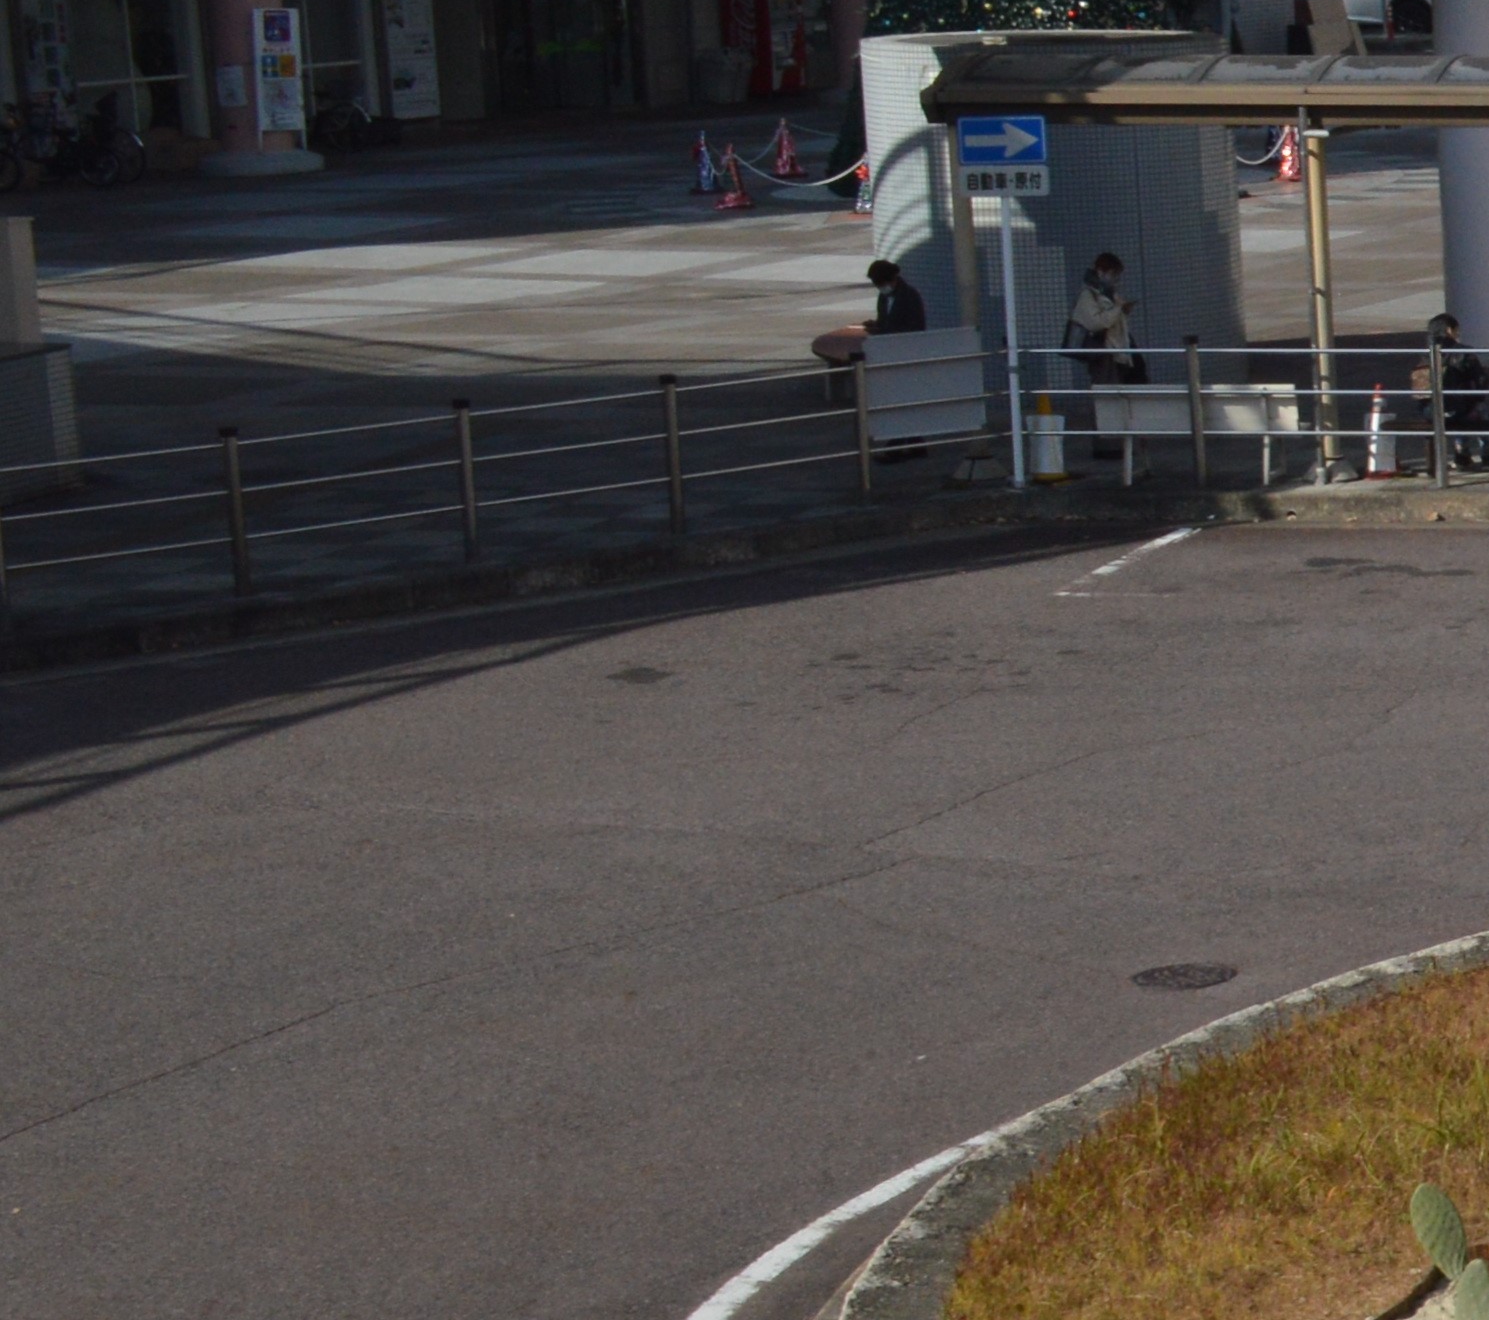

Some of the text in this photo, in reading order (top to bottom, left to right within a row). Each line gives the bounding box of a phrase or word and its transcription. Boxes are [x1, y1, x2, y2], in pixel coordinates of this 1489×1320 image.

[966, 172, 1042, 191] 自動車・原付
